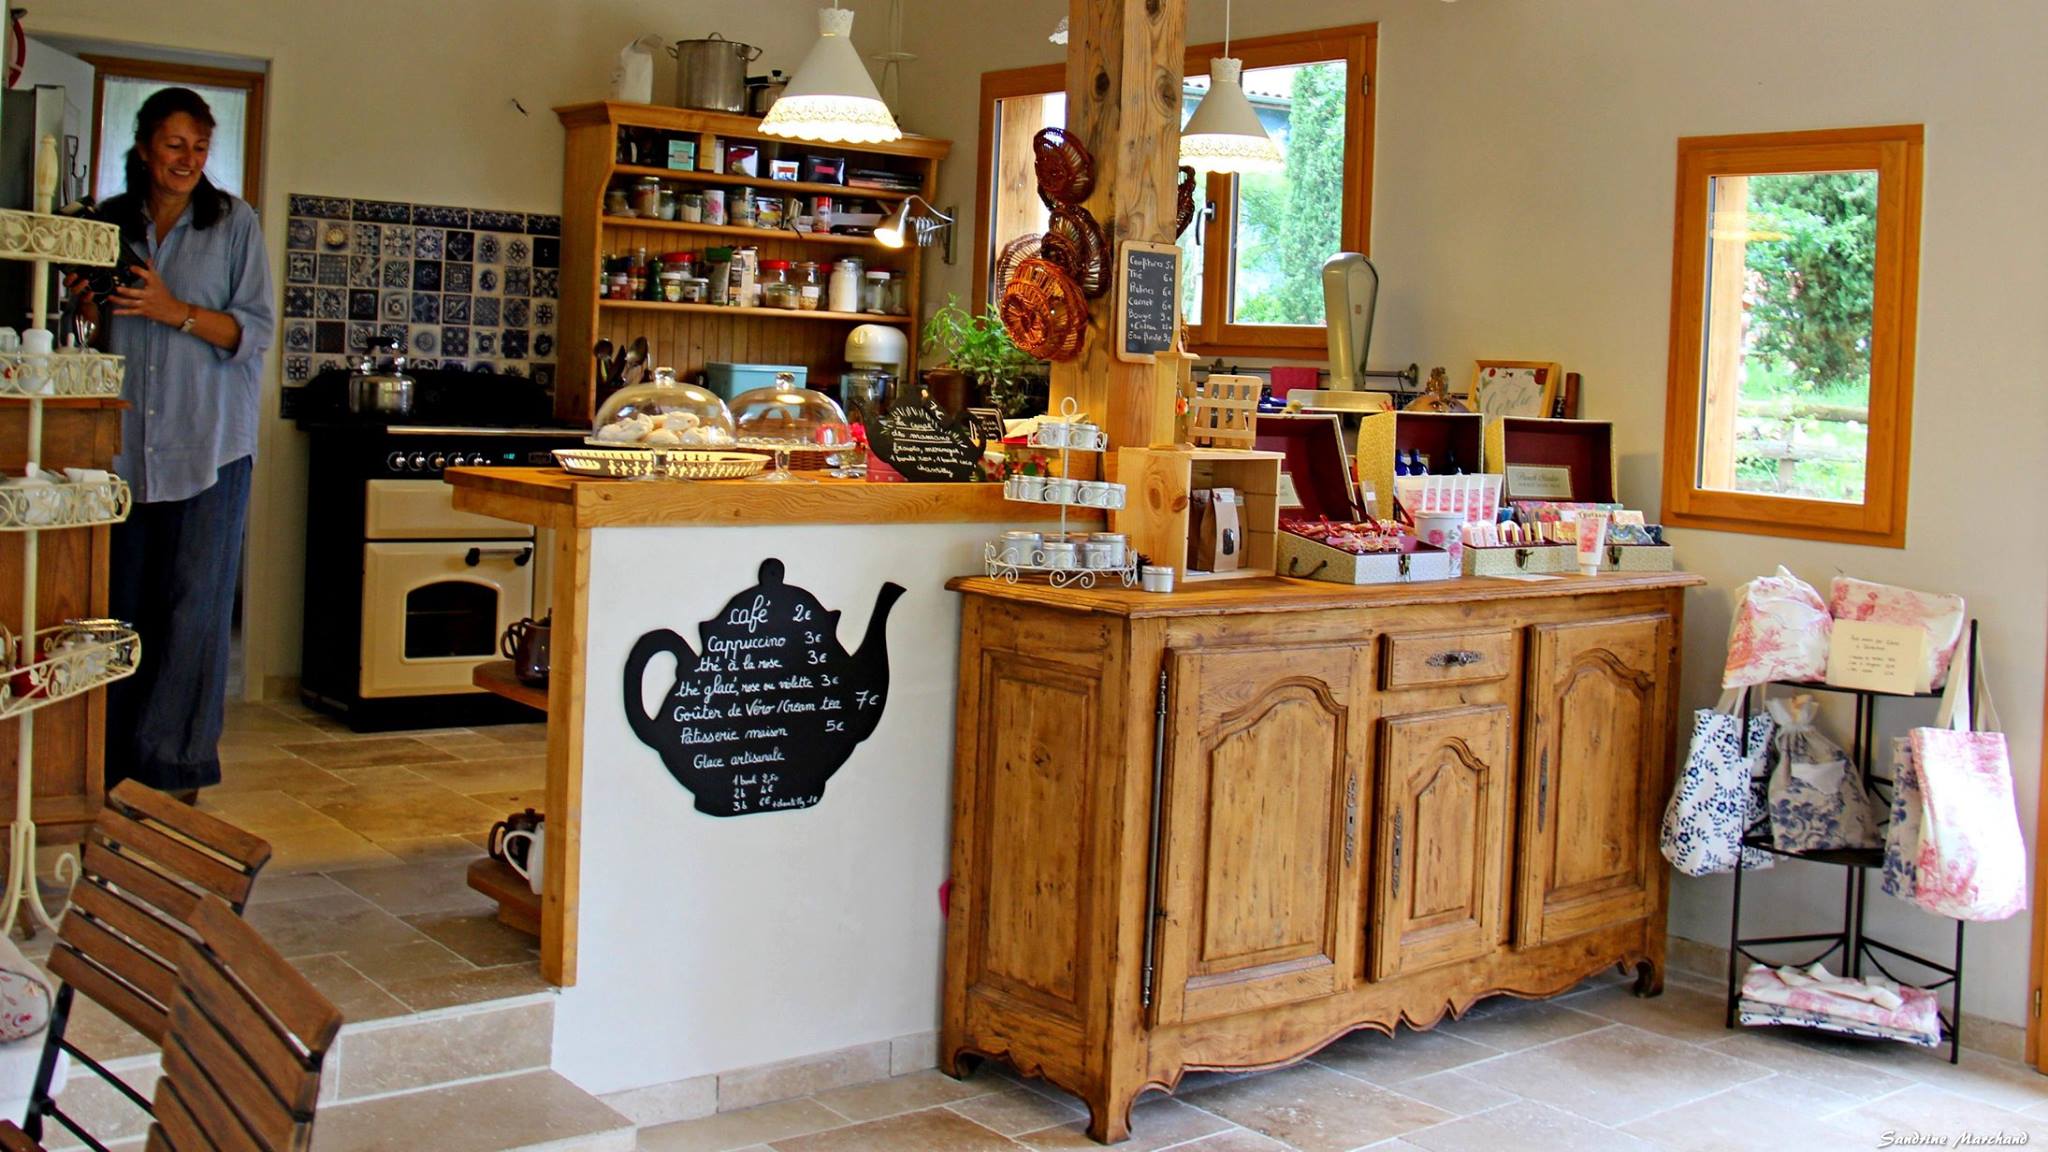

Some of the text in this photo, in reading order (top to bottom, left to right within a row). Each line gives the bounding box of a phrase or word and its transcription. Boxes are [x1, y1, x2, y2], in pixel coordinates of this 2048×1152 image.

[727, 594, 812, 633] café 2€
[707, 631, 822, 660] Cappuccino 3€
[694, 650, 827, 673] thé à la rose 3€
[675, 679, 701, 698] thé
[741, 681, 761, 693] rose
[763, 683, 776, 691] ou
[820, 674, 840, 687] 3€
[674, 703, 723, 722] Goûter
[727, 702, 743, 717] de
[819, 695, 843, 711] tea
[855, 689, 880, 711] 7€
[744, 725, 789, 739] maison
[824, 719, 845, 733] 5€
[693, 746, 786, 769] Glace artisanale
